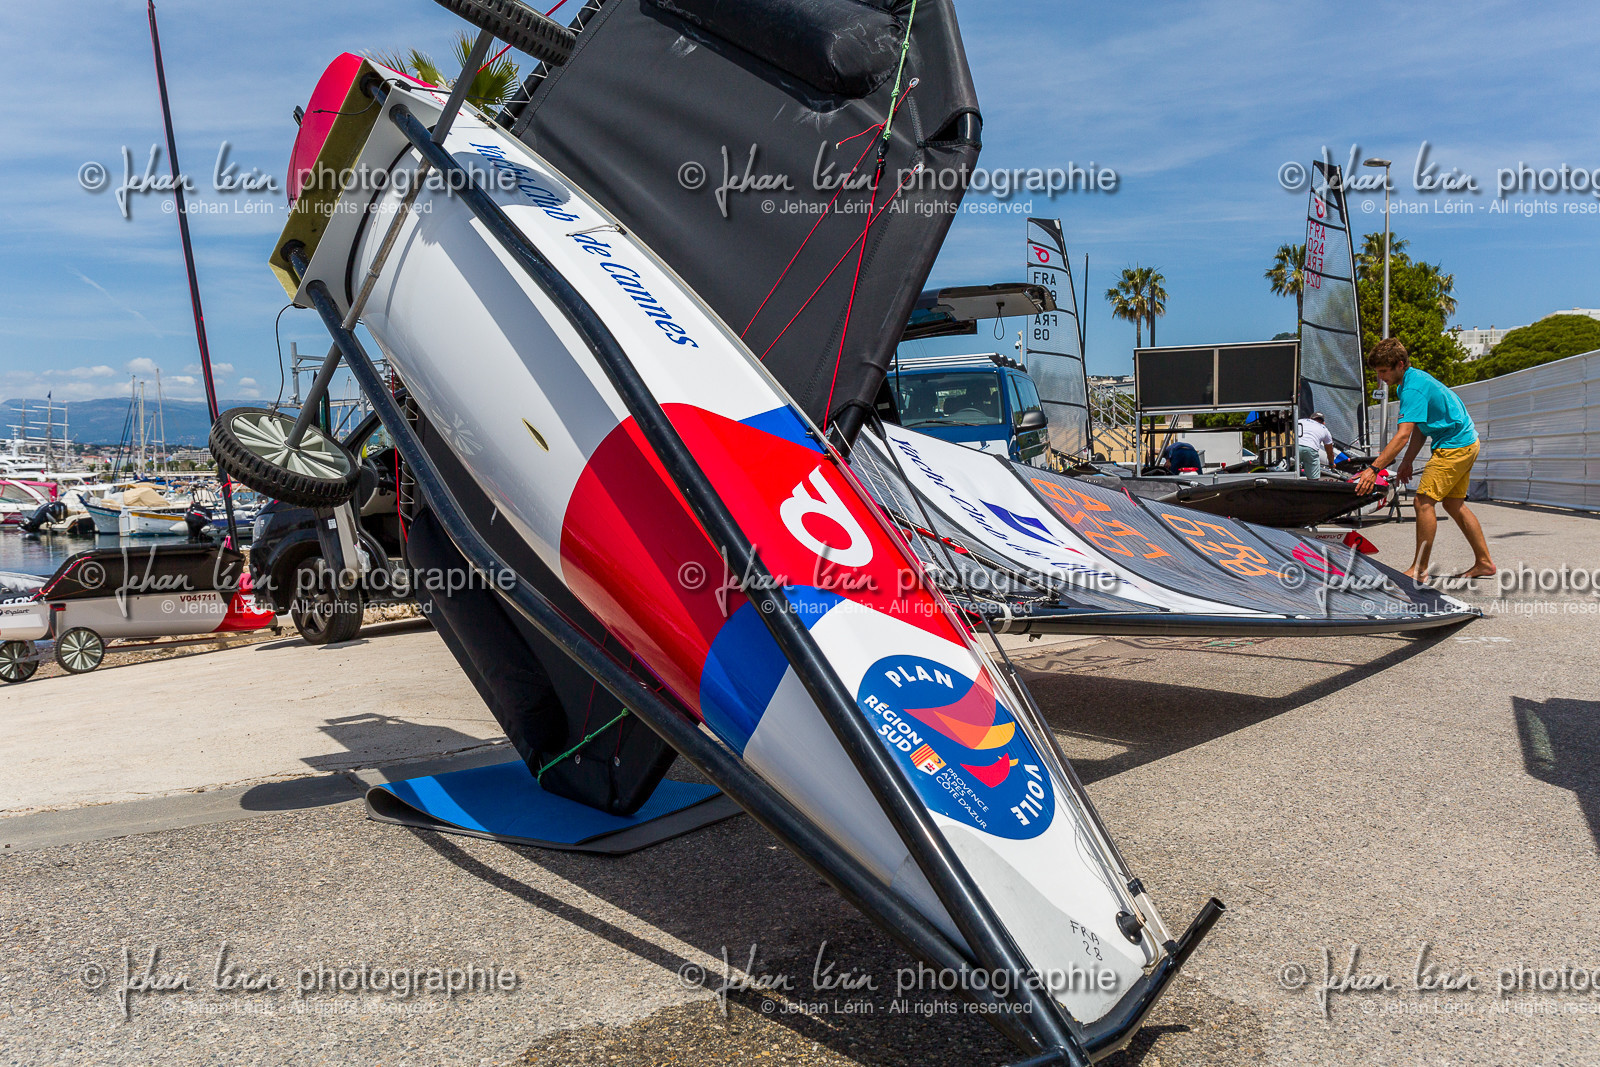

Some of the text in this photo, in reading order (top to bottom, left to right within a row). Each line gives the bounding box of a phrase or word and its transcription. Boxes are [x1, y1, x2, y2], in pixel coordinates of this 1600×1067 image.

[1309, 220, 1326, 241] FRA
[469, 142, 700, 349] Yacht Club de Cannes
[1307, 237, 1325, 257] 024
[1033, 271, 1057, 286] FRA
[950, 494, 1008, 541] Club
[884, 665, 954, 689] PLAN
[863, 694, 924, 746] RÉGION
[877, 723, 912, 752] SUD
[941, 772, 967, 797] ALPES
[946, 767, 990, 813] PROVENCE
[1009, 763, 1045, 826] VOILE
[957, 797, 988, 830] D'AZUR
[1069, 919, 1101, 946] FRA
